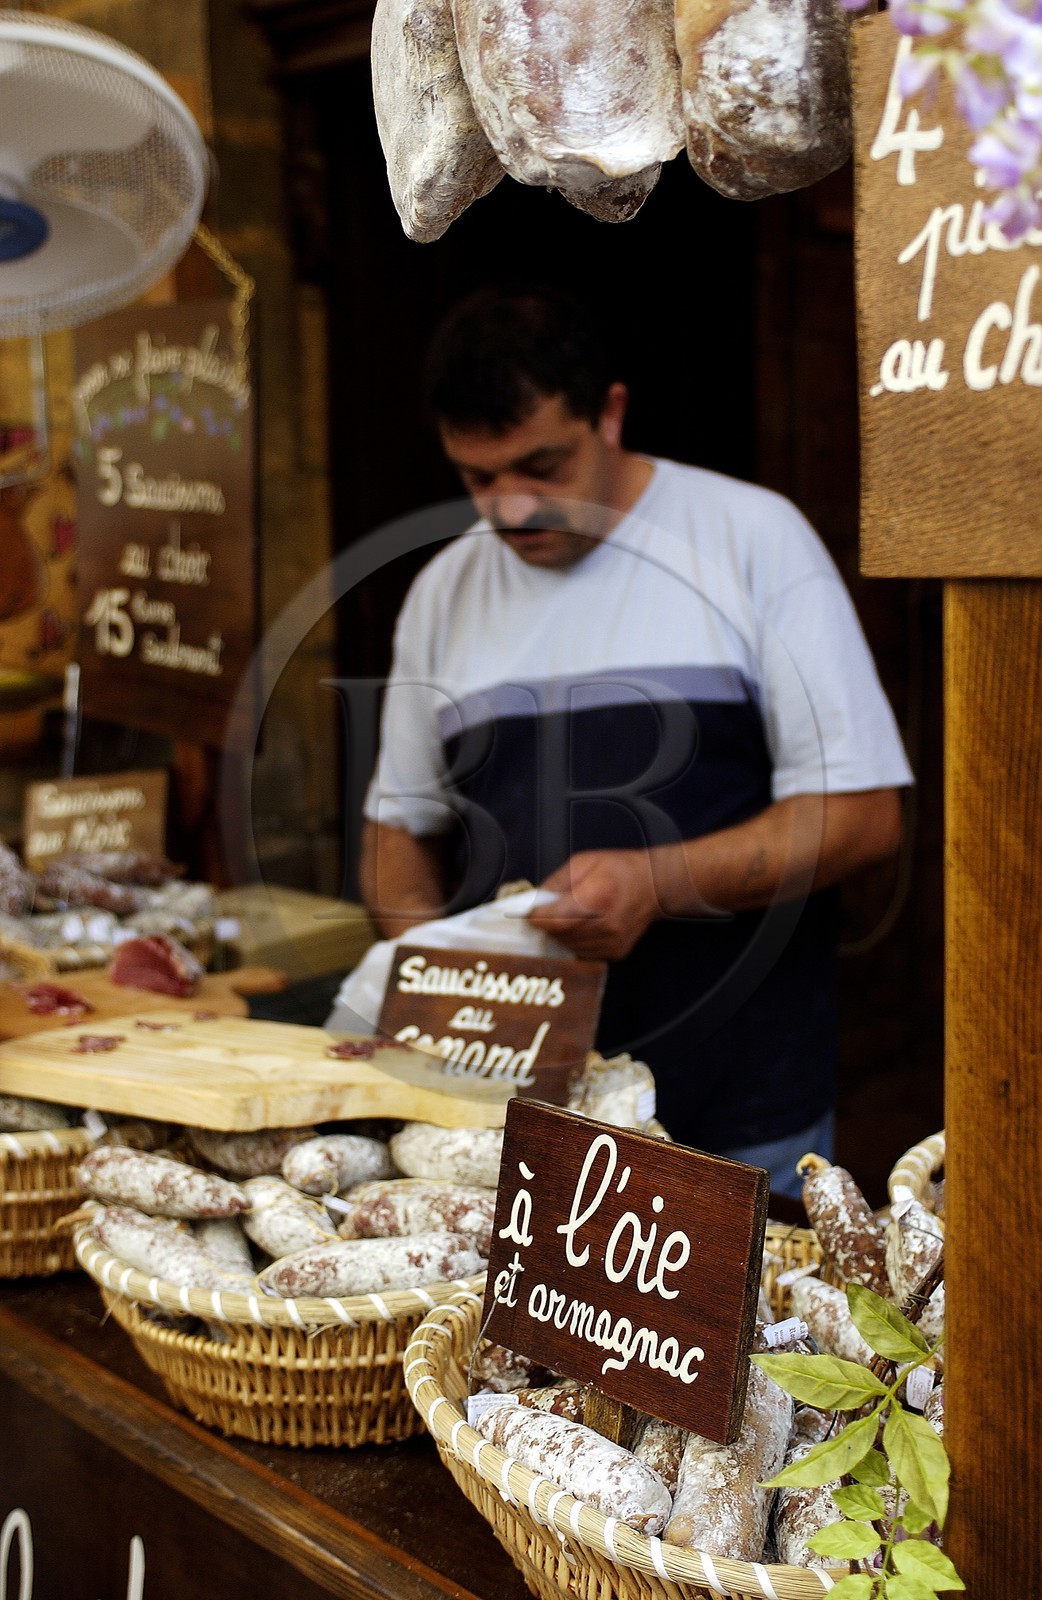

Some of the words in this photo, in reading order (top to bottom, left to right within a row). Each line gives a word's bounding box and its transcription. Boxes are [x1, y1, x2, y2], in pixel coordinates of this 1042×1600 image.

[870, 36, 945, 186] 4
[869, 338, 949, 397] au
[99, 447, 122, 506] 5
[86, 587, 134, 657] 15
[398, 955, 565, 1007] Saucissons
[448, 1005, 497, 1033] au
[499, 1161, 535, 1247] à
[556, 1134, 691, 1299] l'oie
[494, 1251, 525, 1308] et
[528, 1283, 704, 1384] armagnac
